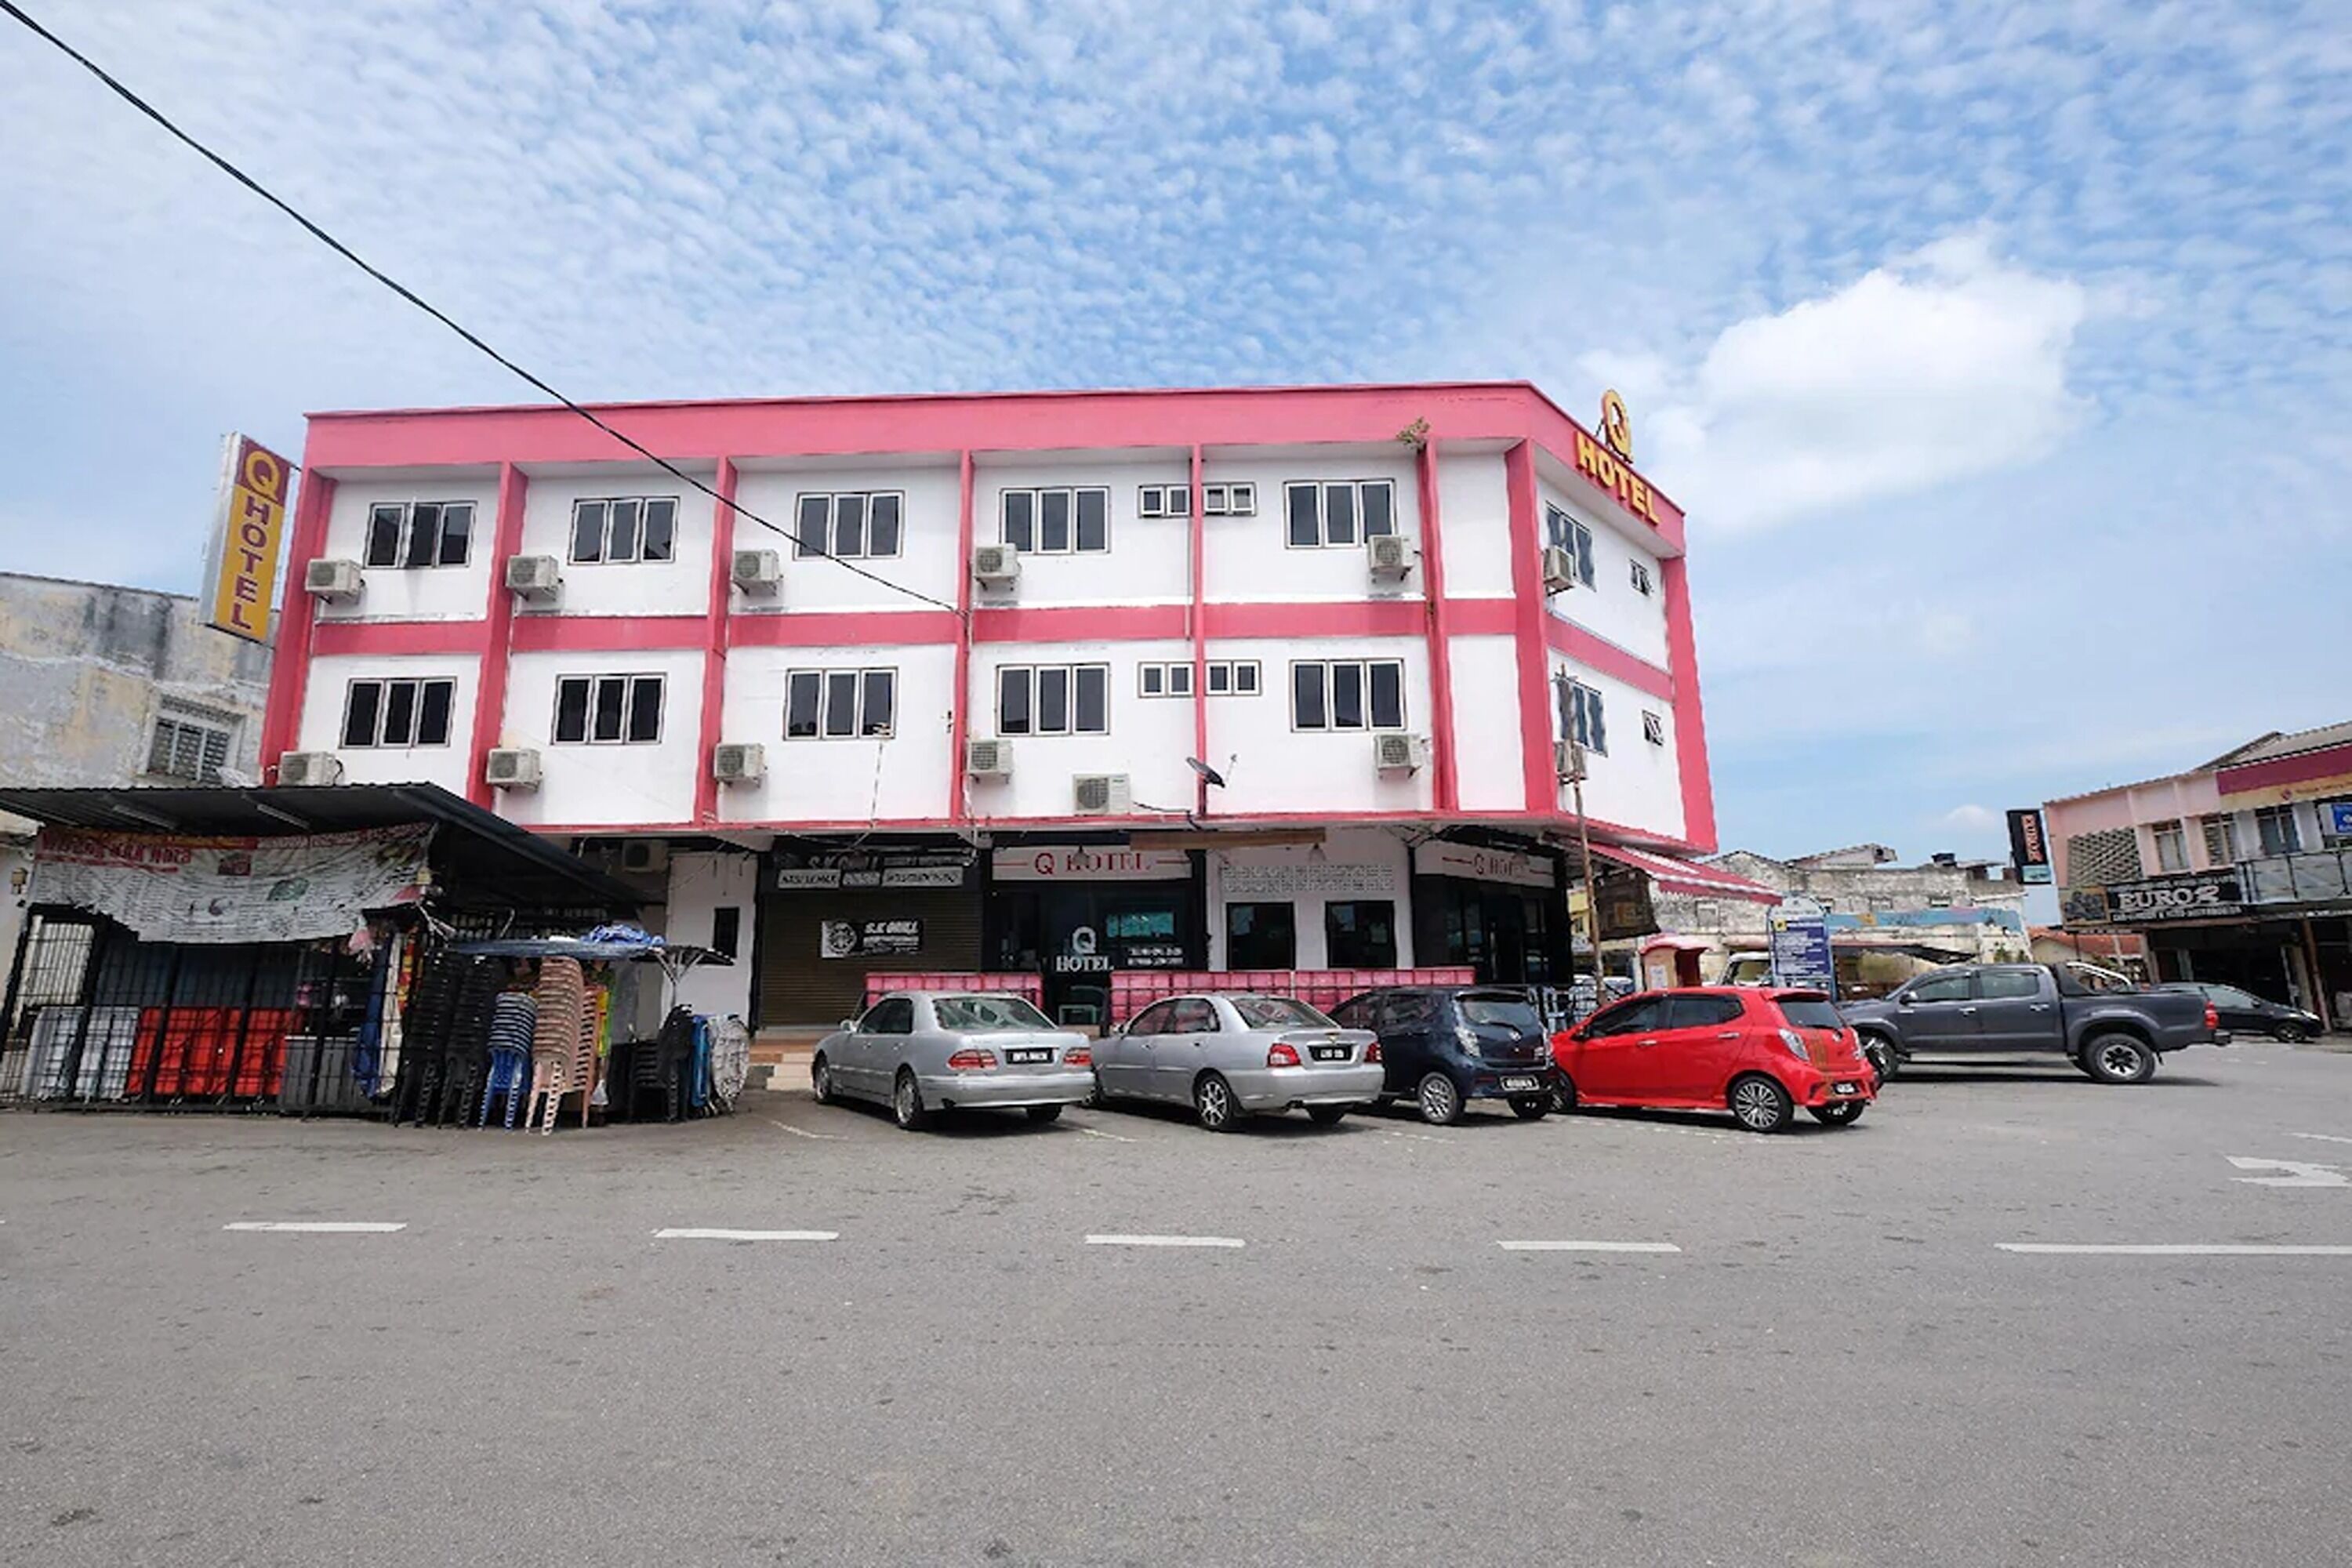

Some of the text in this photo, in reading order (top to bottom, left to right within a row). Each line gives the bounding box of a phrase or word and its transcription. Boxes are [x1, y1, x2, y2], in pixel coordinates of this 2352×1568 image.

[1602, 389, 1634, 463] Q
[245, 450, 283, 502] Q
[1574, 431, 1661, 526] HOTEL
[230, 495, 270, 630] HOTEL
[1034, 851, 1055, 876] Q
[1055, 955, 1115, 973] HOTEL
[1072, 925, 1098, 954] Q
